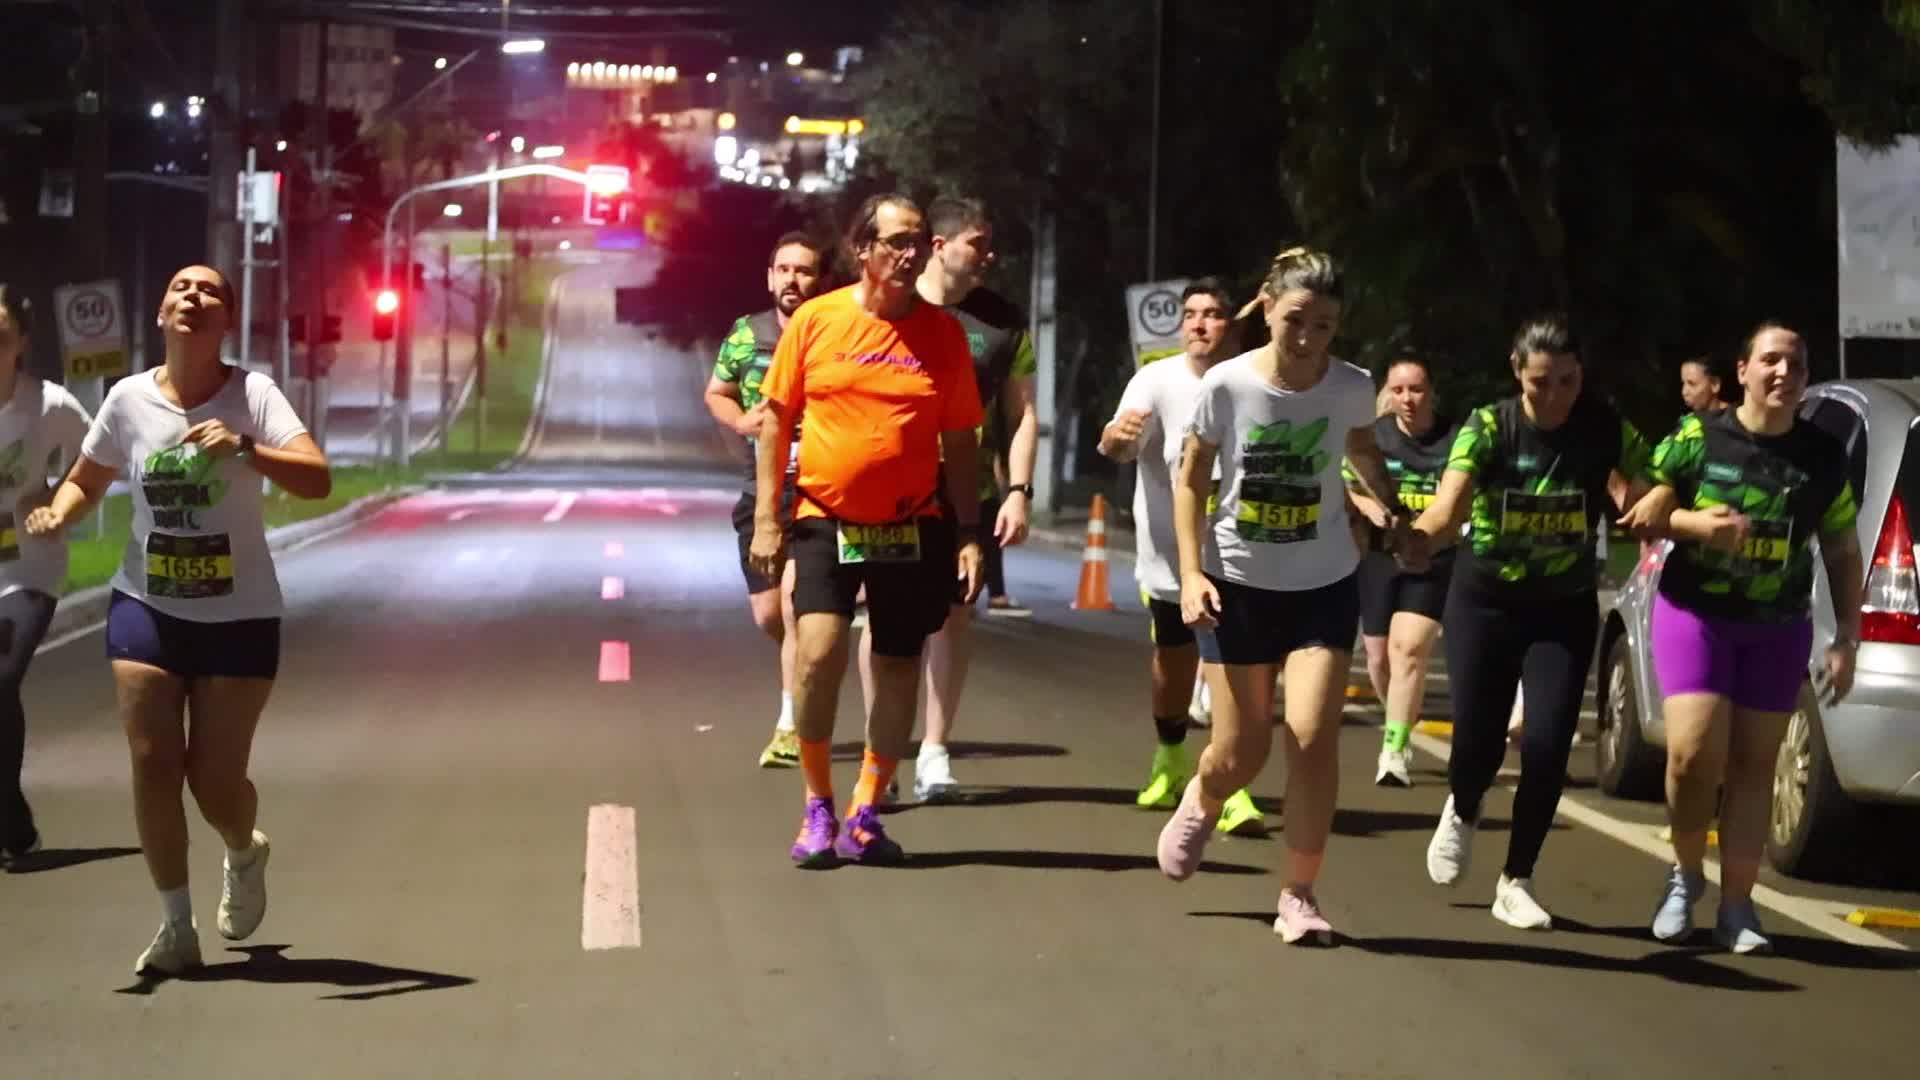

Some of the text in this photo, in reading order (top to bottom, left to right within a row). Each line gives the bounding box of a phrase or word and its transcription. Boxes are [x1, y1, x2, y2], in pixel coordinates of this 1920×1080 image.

[75, 300, 105, 320] 50
[1147, 298, 1176, 319] 50
[1254, 502, 1309, 526] 1518
[161, 557, 218, 579] 1655
